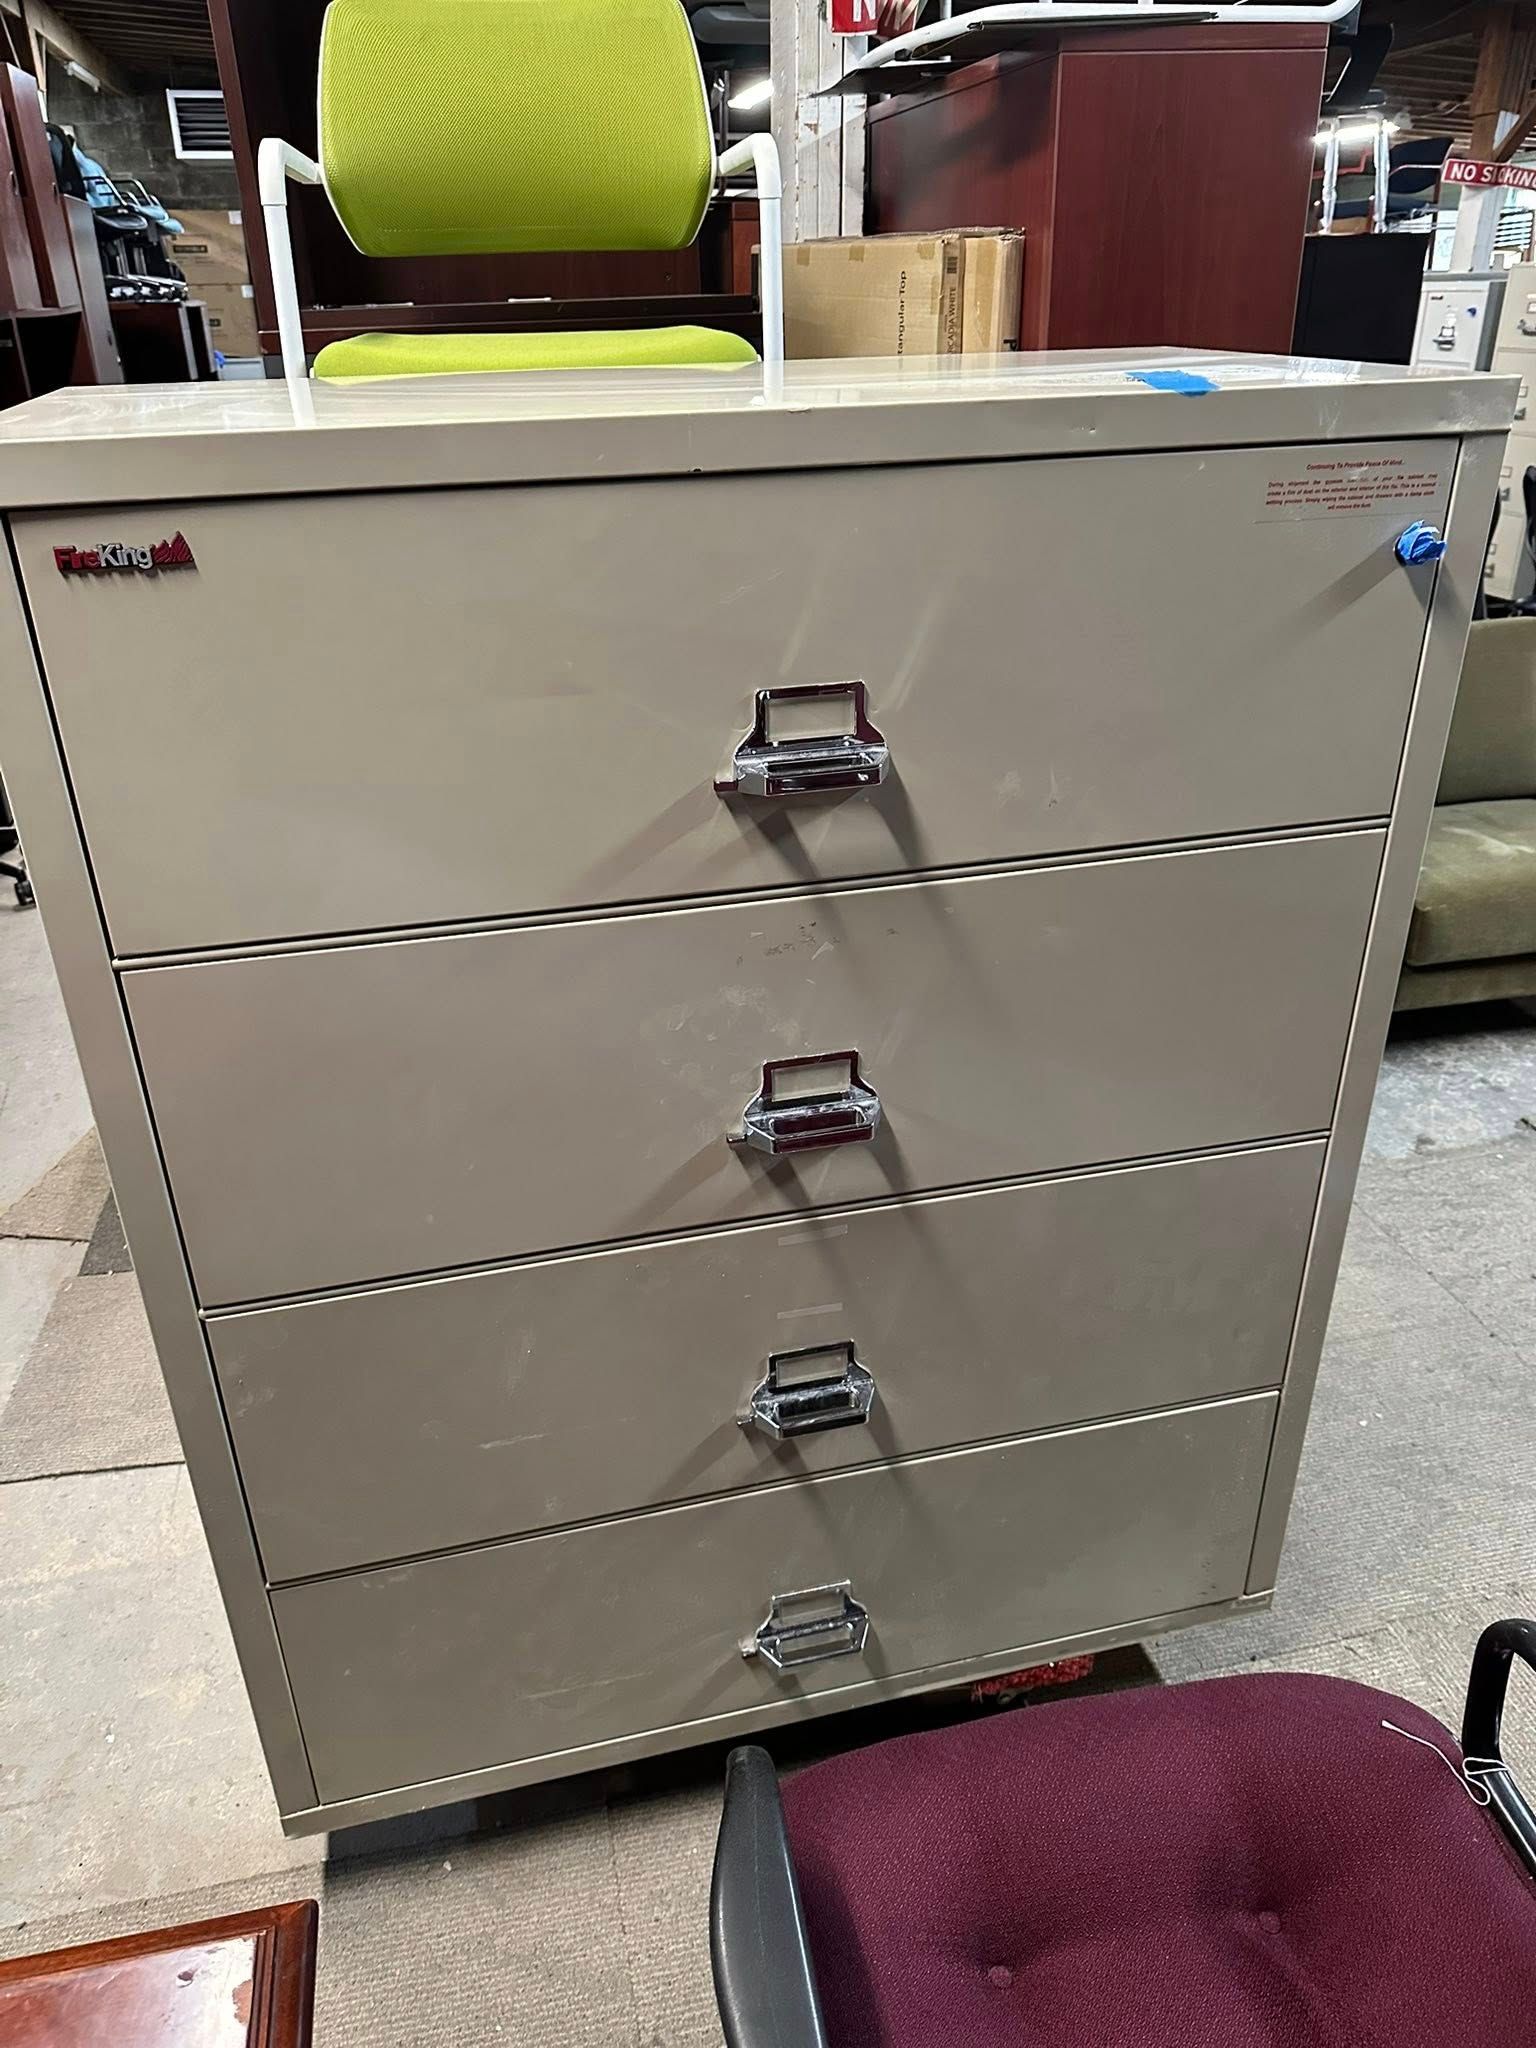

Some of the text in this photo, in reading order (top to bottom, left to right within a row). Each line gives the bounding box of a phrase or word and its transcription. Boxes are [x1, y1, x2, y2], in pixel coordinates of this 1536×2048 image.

[1450, 162, 1476, 181] NO
[899, 270, 907, 297] Top
[948, 286, 957, 316] WHITE
[1305, 463, 1336, 471] Continuing
[52, 542, 154, 571] FireKing
